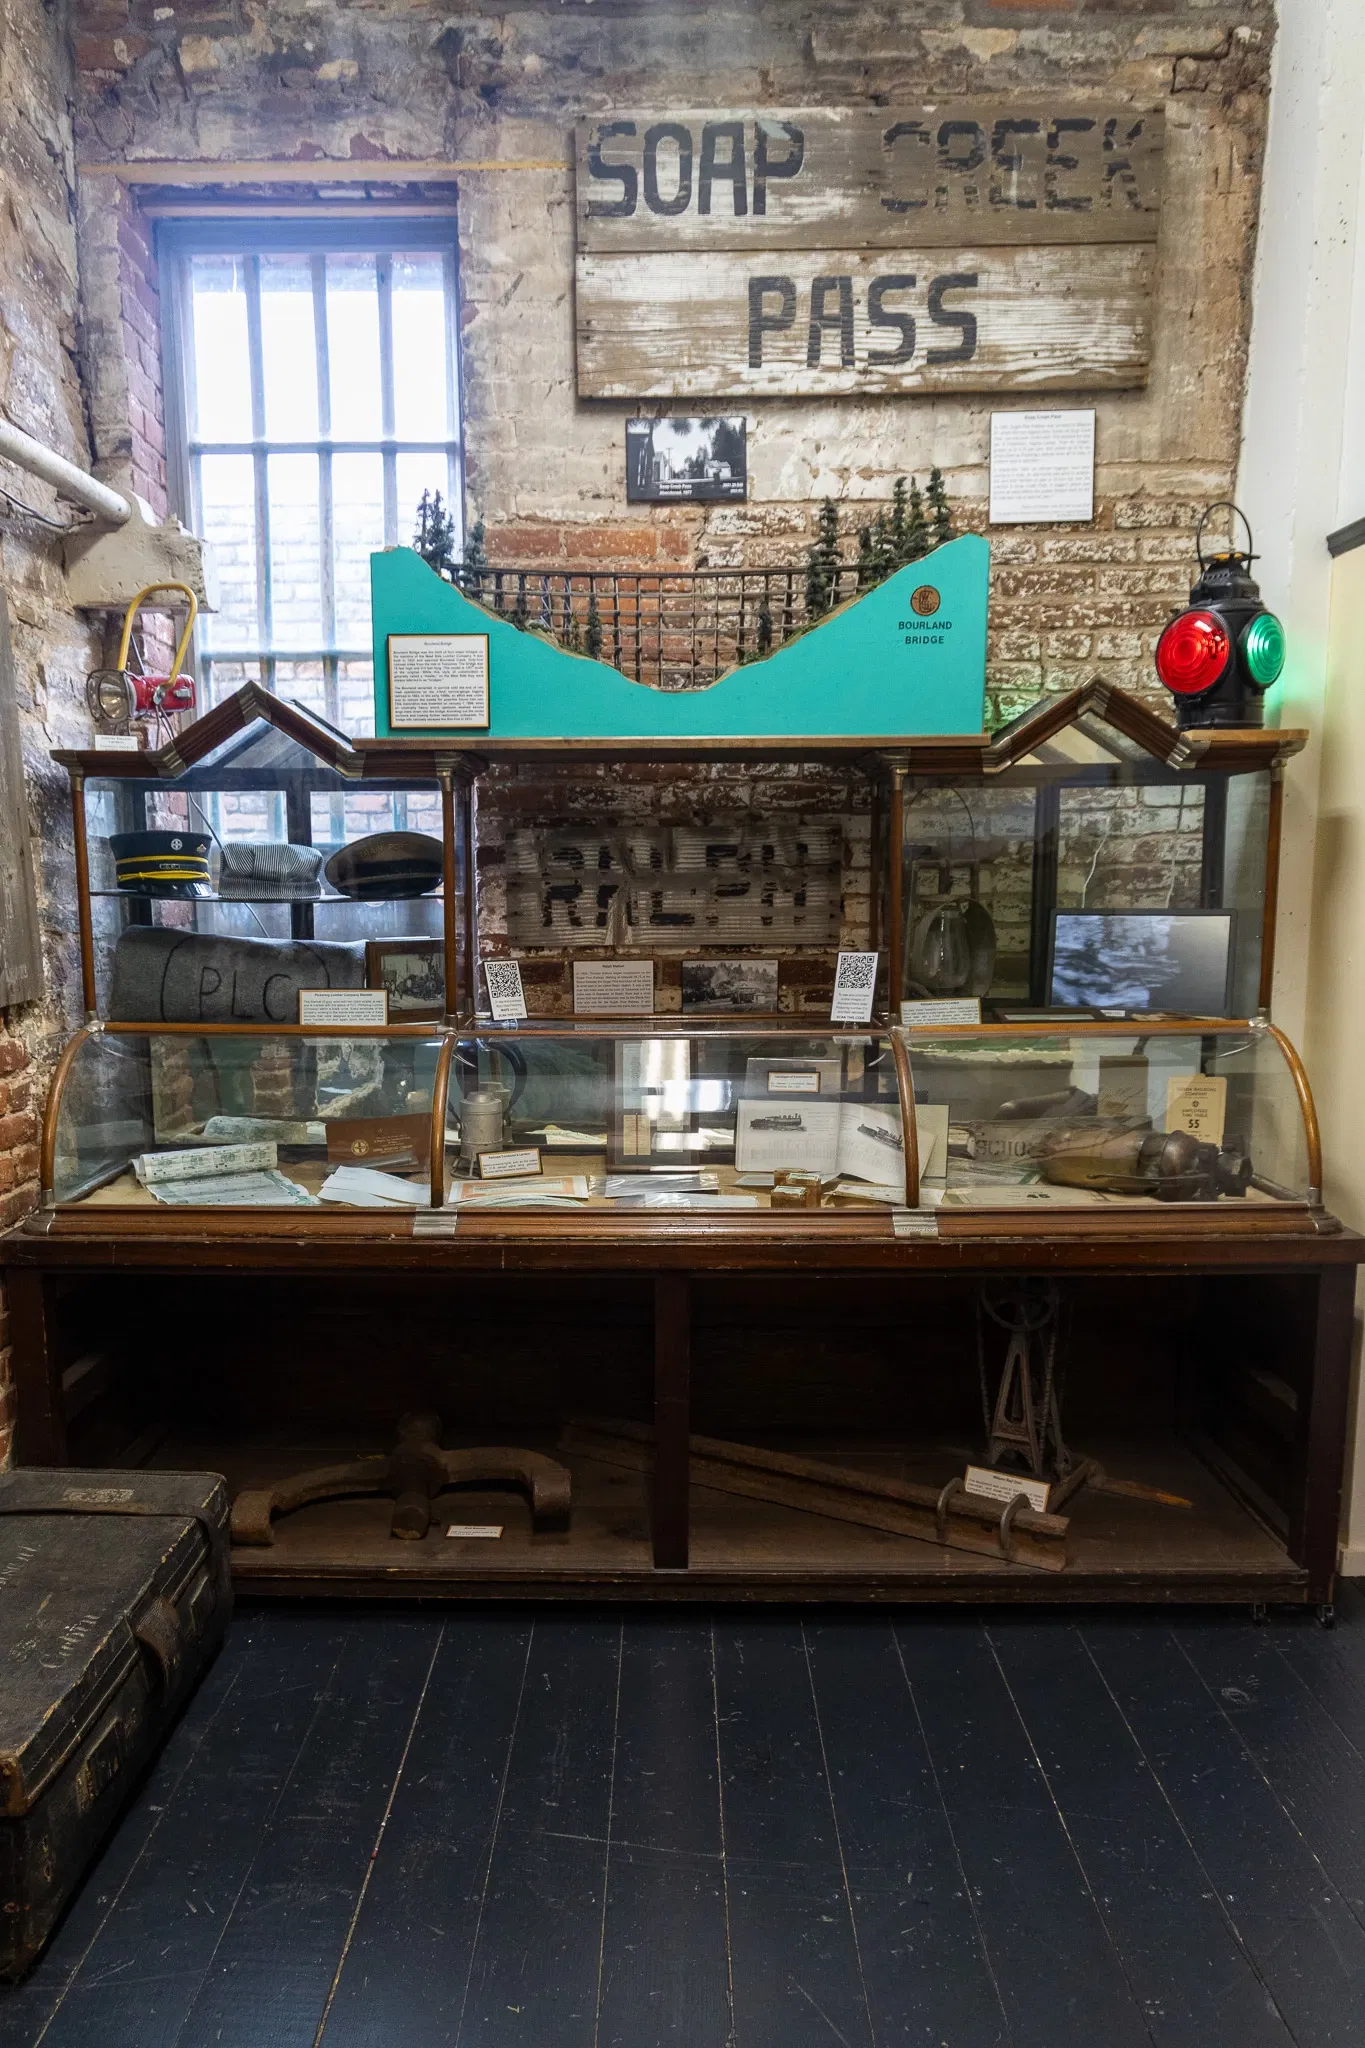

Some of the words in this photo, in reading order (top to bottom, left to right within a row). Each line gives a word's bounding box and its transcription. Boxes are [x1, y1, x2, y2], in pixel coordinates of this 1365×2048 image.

[587, 120, 804, 217] SOAP
[880, 117, 1147, 214] CREEK
[747, 273, 979, 369] PASS
[898, 621, 952, 630] BOURLAND
[905, 636, 944, 645] BRIDGE
[198, 966, 292, 1022] PLC
[1188, 1119, 1200, 1128] 55
